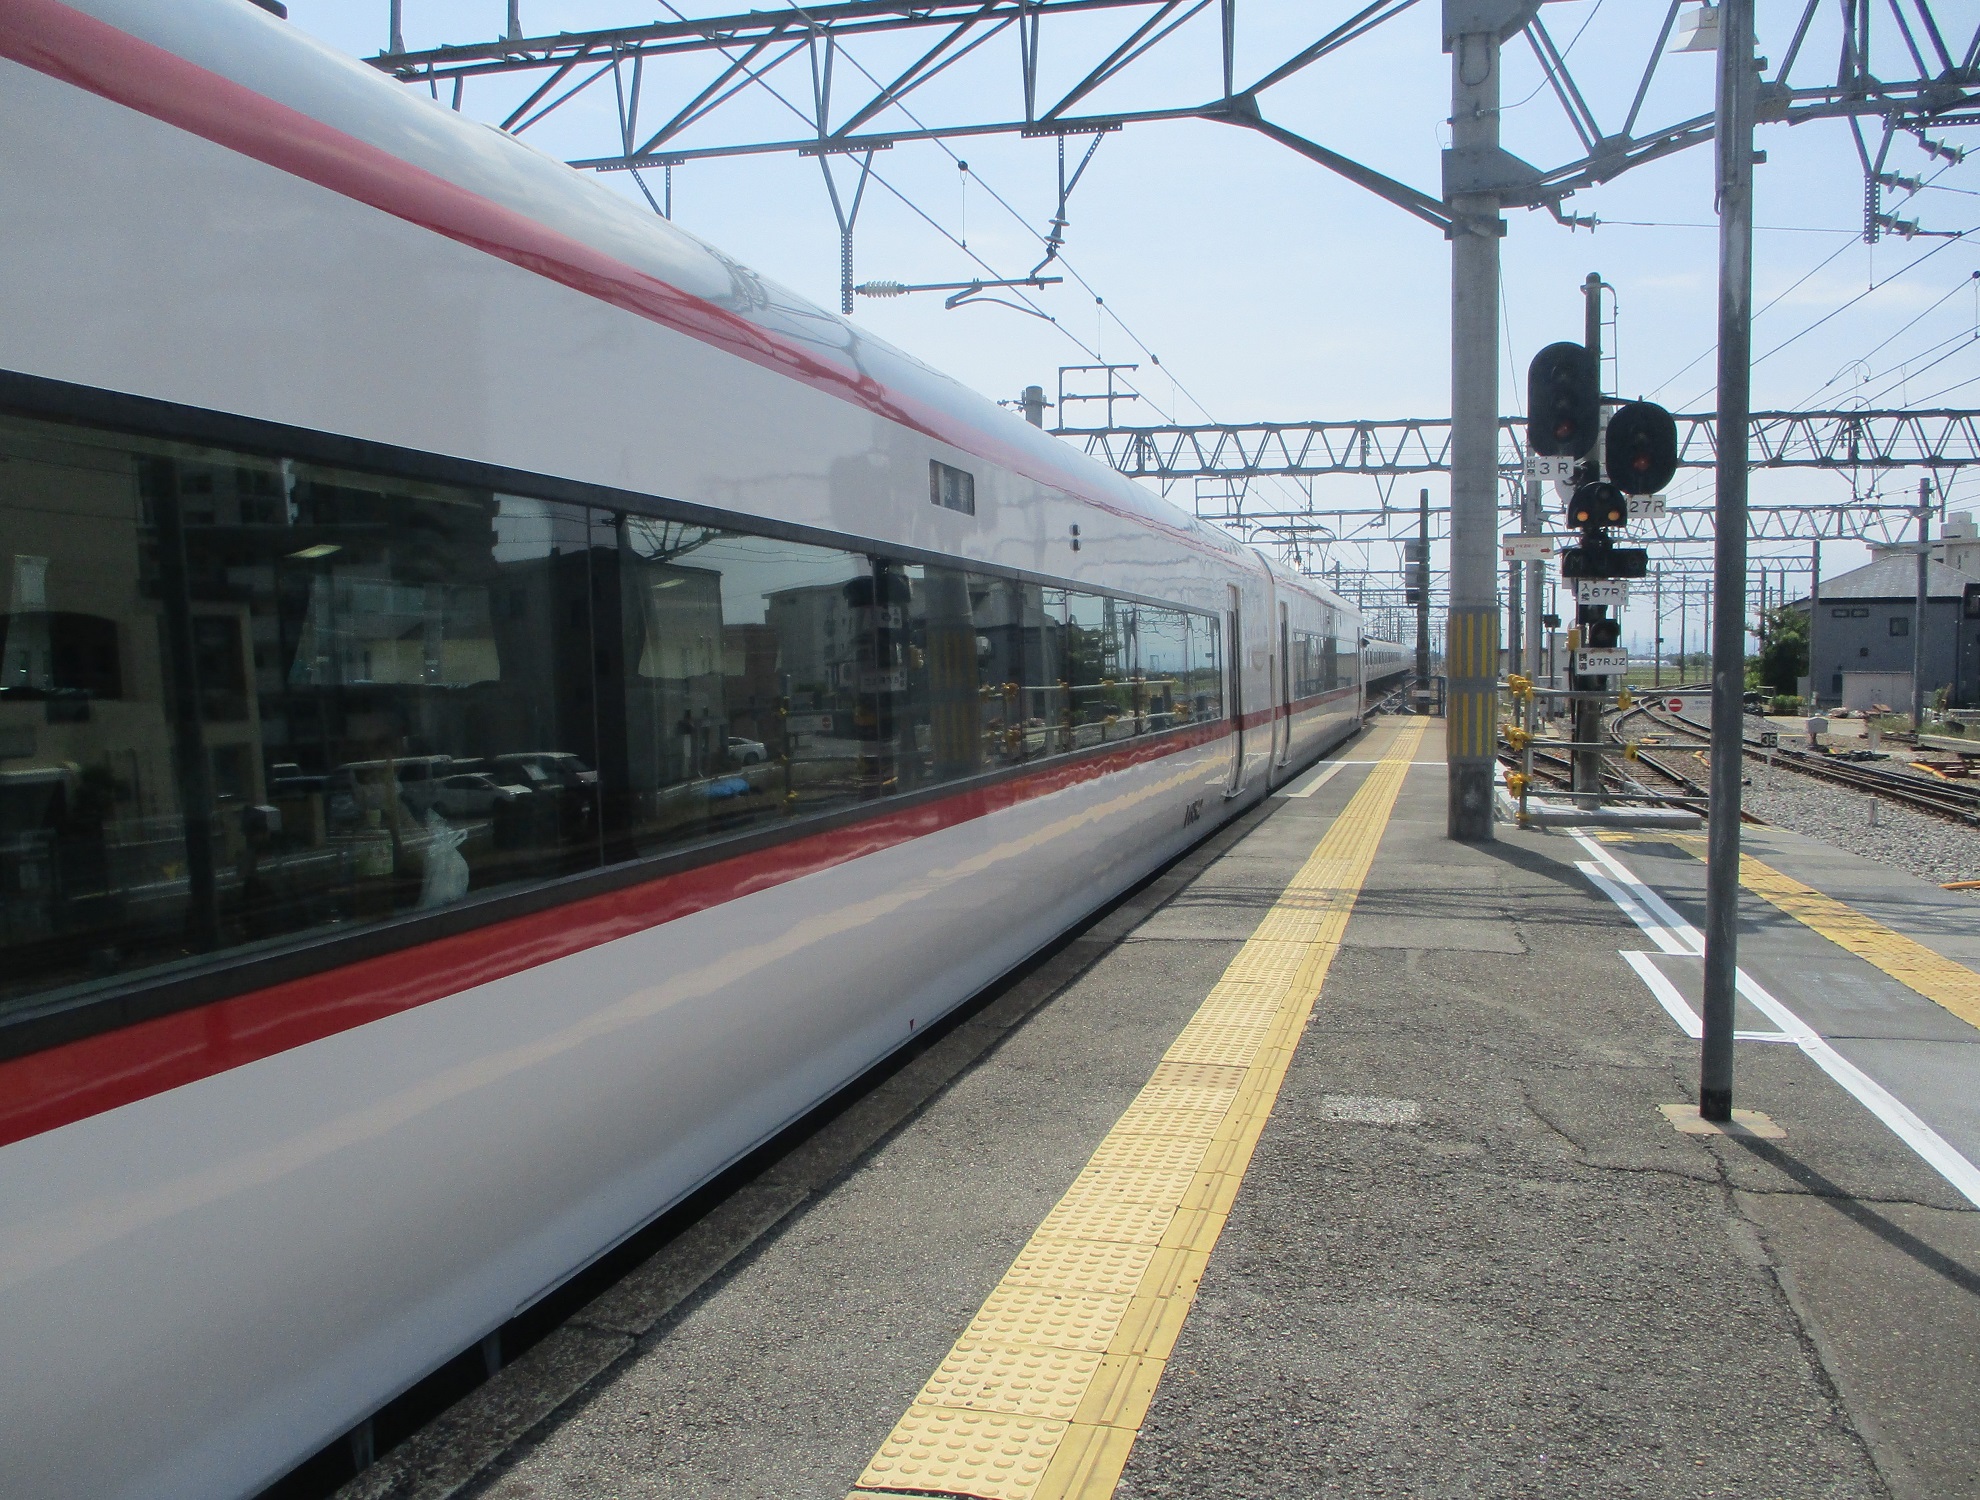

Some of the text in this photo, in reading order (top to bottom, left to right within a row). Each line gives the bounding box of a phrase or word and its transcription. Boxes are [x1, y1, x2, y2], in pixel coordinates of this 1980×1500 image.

[1630, 500, 1665, 513] 27R
[1592, 587, 1620, 598] 67R
[1761, 734, 1777, 747] 35
